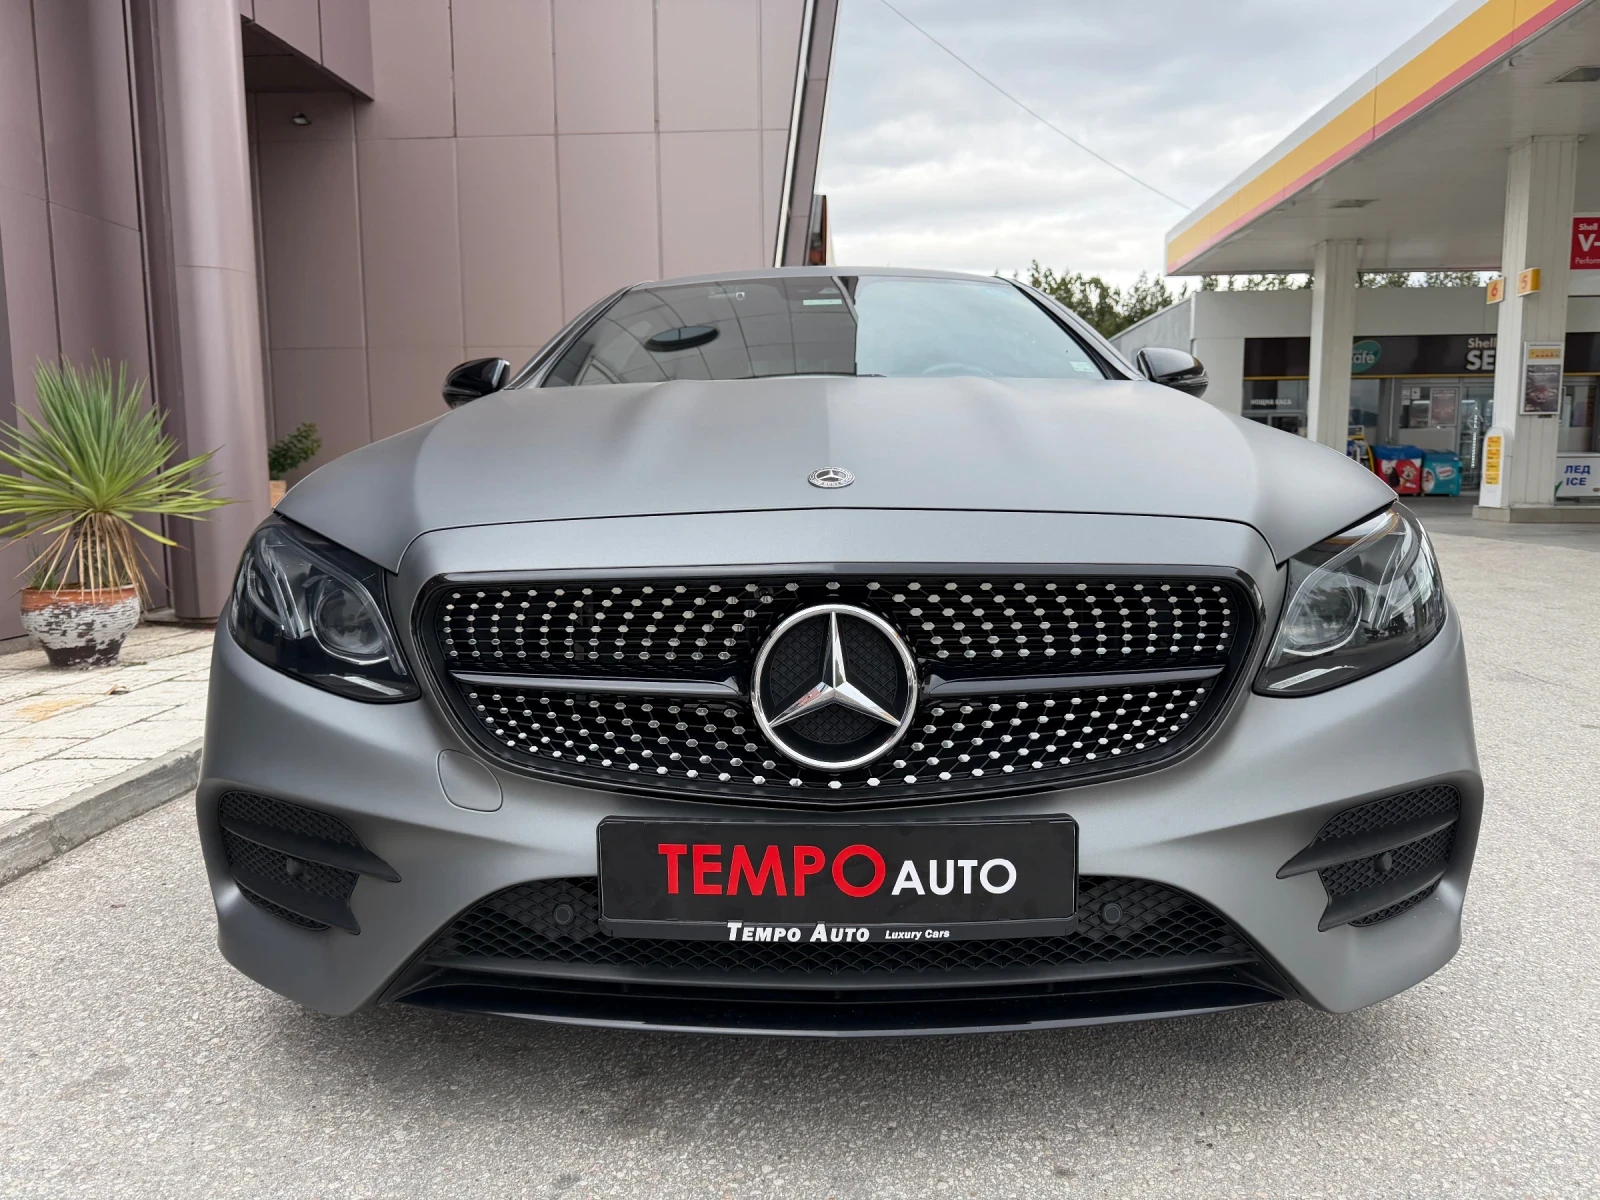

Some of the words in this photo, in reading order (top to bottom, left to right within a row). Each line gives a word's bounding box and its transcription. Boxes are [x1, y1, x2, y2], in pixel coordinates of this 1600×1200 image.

[1521, 274, 1528, 290] 5
[1491, 282, 1499, 297] 6
[1467, 337, 1497, 348] Shell
[1351, 350, 1375, 364] afé
[1564, 465, 1591, 475] ЛЕД
[1565, 477, 1587, 486] ICE
[658, 843, 886, 898] TEMPO
[891, 857, 1017, 897] AUTO
[885, 929, 922, 941] Luxury
[924, 929, 950, 939] Cars
